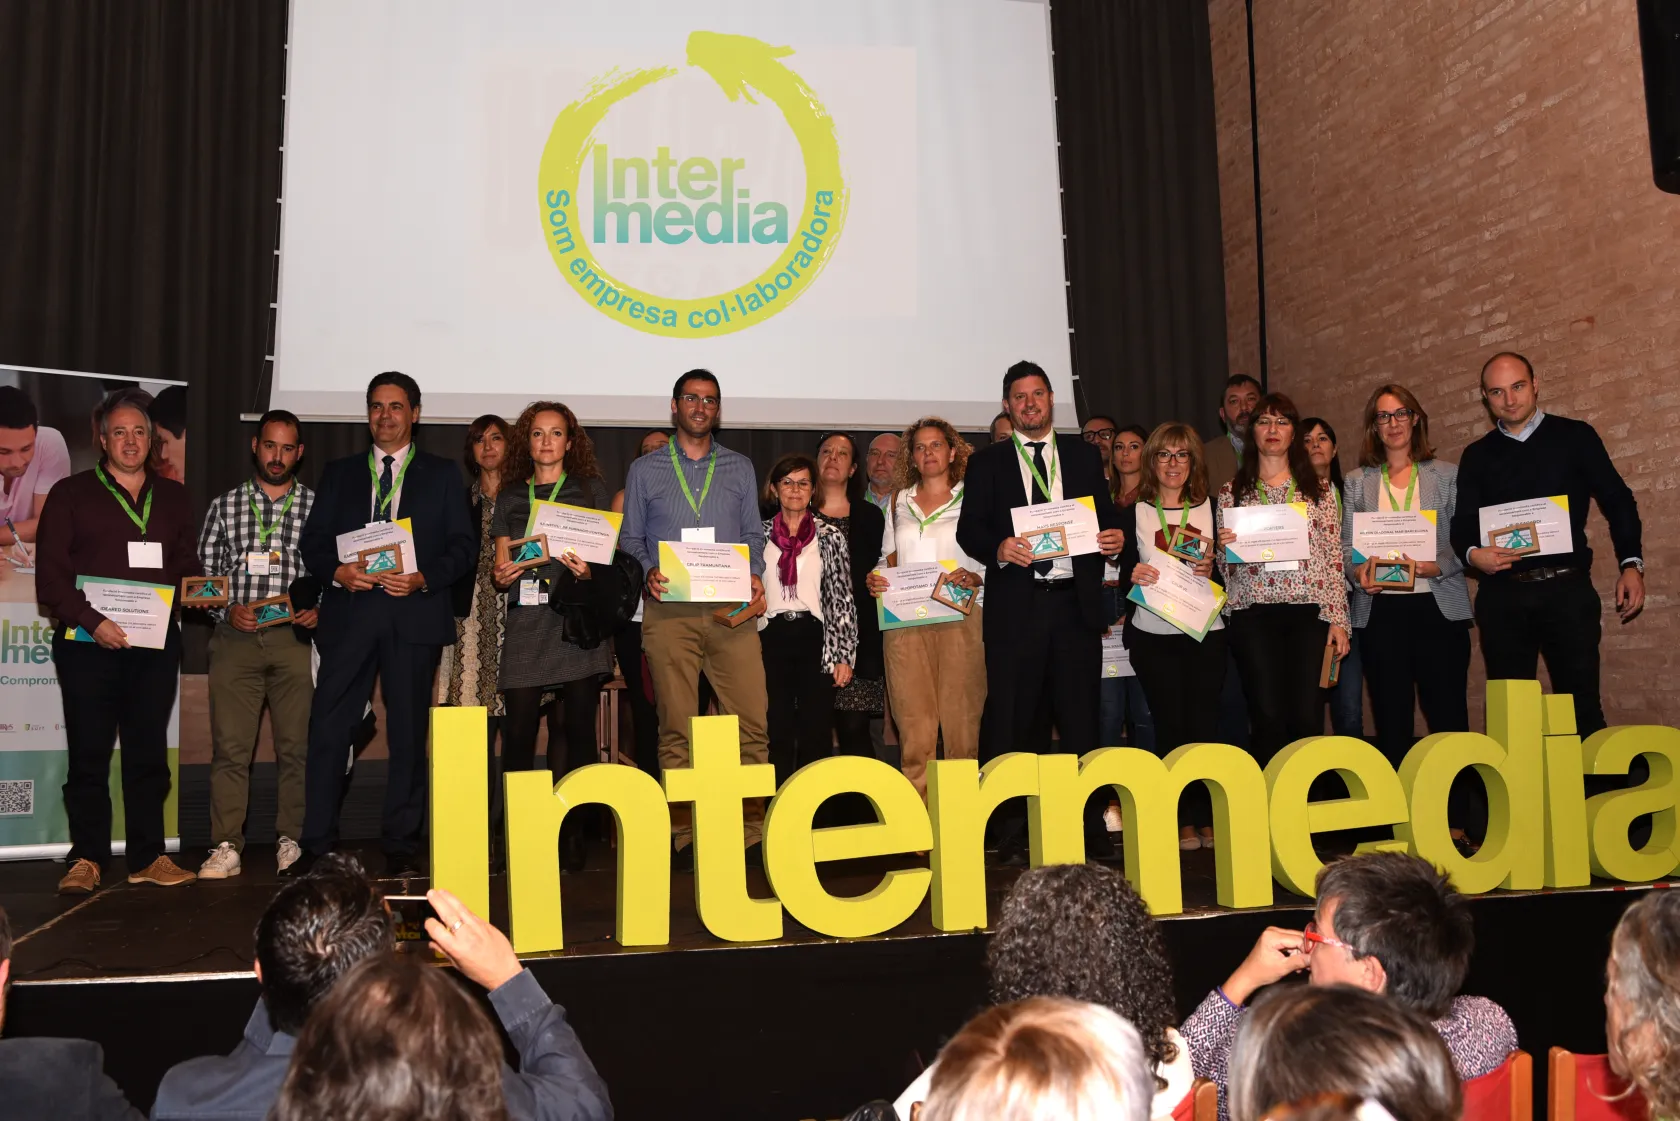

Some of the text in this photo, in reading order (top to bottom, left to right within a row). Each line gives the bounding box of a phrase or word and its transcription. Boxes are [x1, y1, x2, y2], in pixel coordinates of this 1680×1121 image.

[593, 144, 745, 200] Inter
[593, 188, 789, 245] media
[546, 189, 576, 254] Som
[569, 257, 678, 327] empresa
[2, 619, 55, 646] Inte
[0, 675, 60, 687] Comprom
[429, 679, 1680, 953] Intermedia
